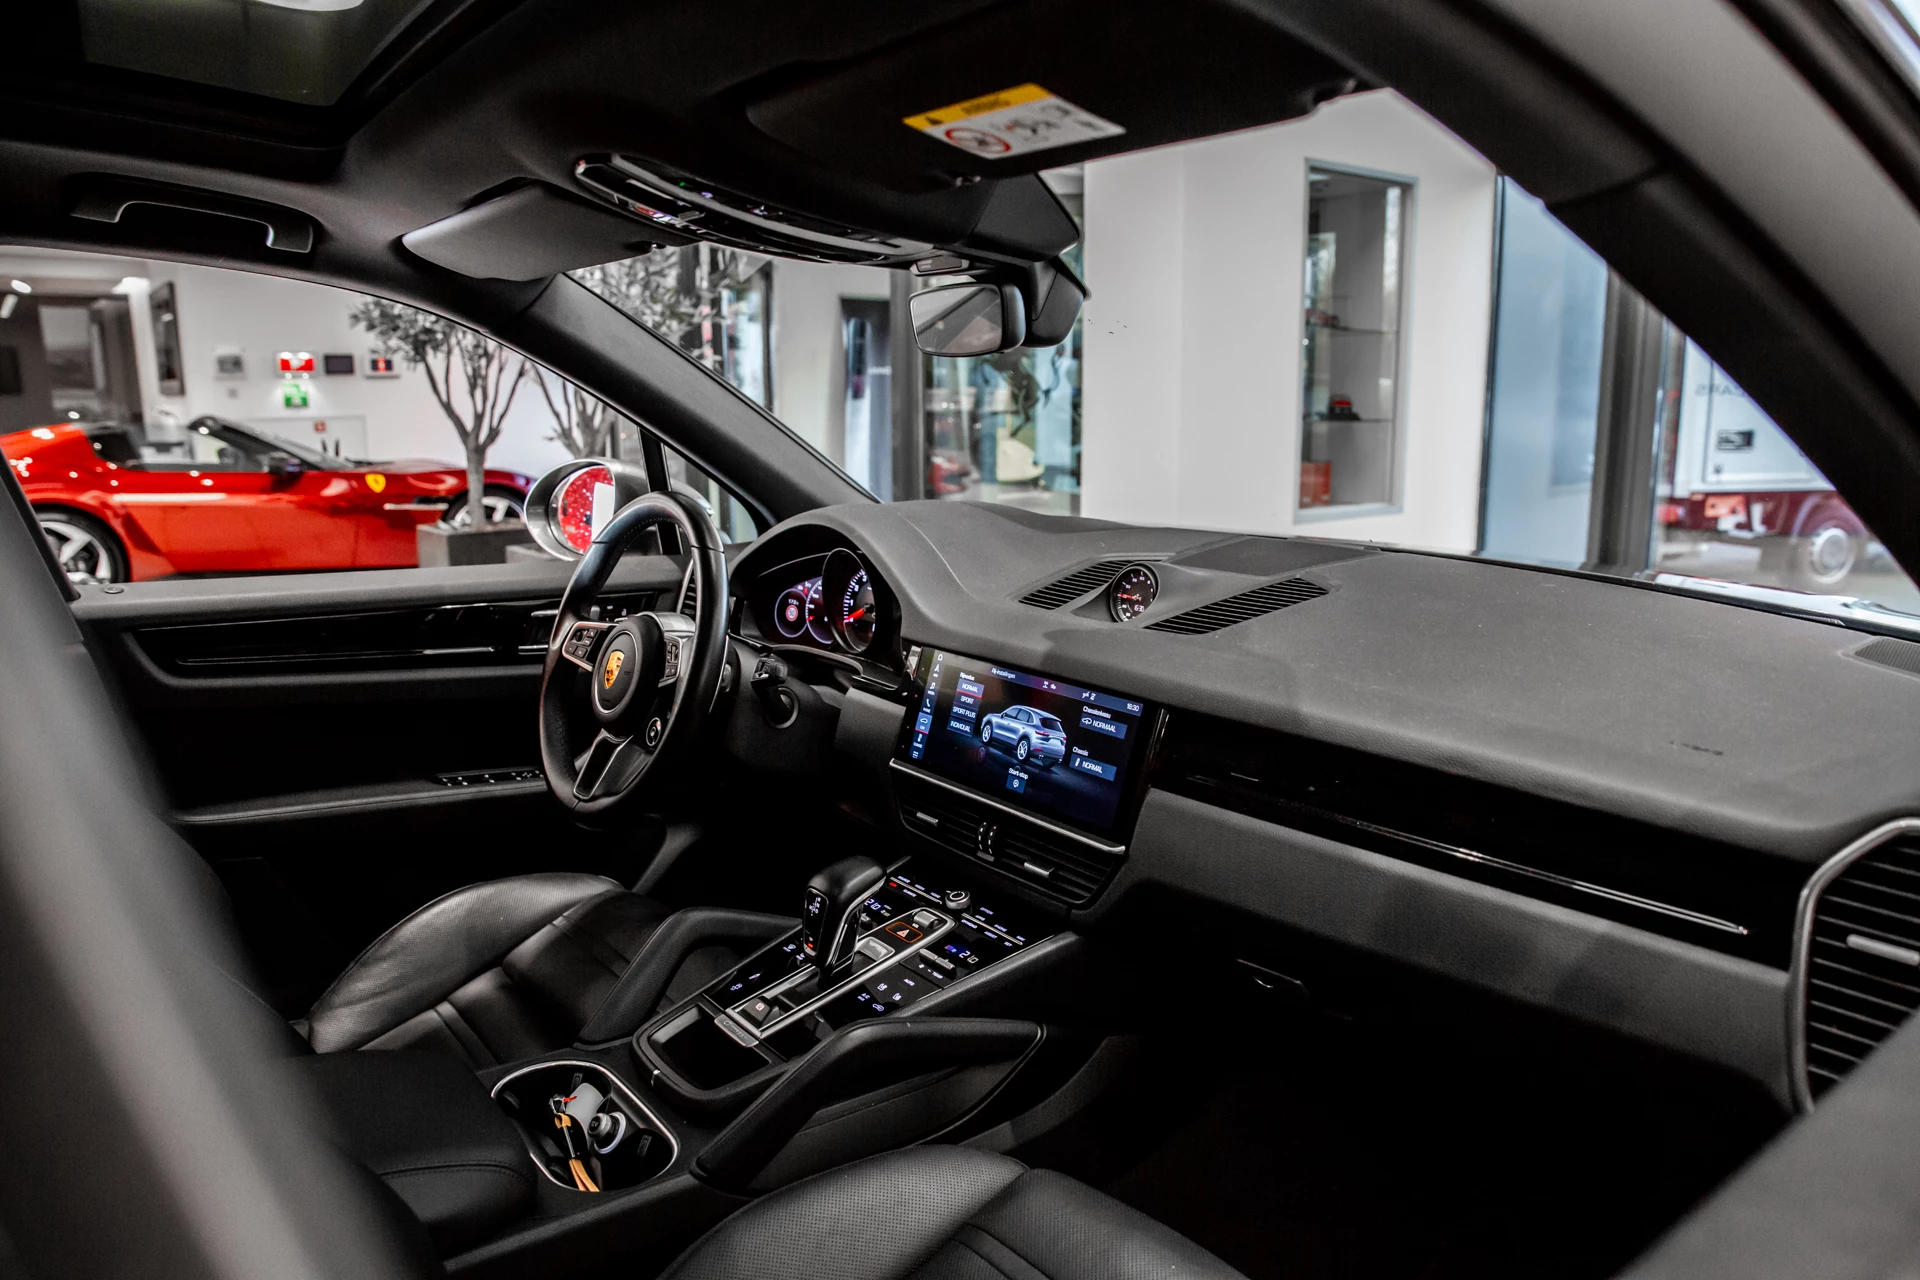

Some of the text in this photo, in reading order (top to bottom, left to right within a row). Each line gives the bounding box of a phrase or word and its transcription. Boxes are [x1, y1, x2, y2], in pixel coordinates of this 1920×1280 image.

[961, 683, 978, 693] NORMAL
[960, 695, 974, 705] SPORT
[953, 706, 977, 718] SPORT PLUS
[1092, 720, 1116, 733] NORMAAL
[1082, 761, 1103, 773] NORMAL
